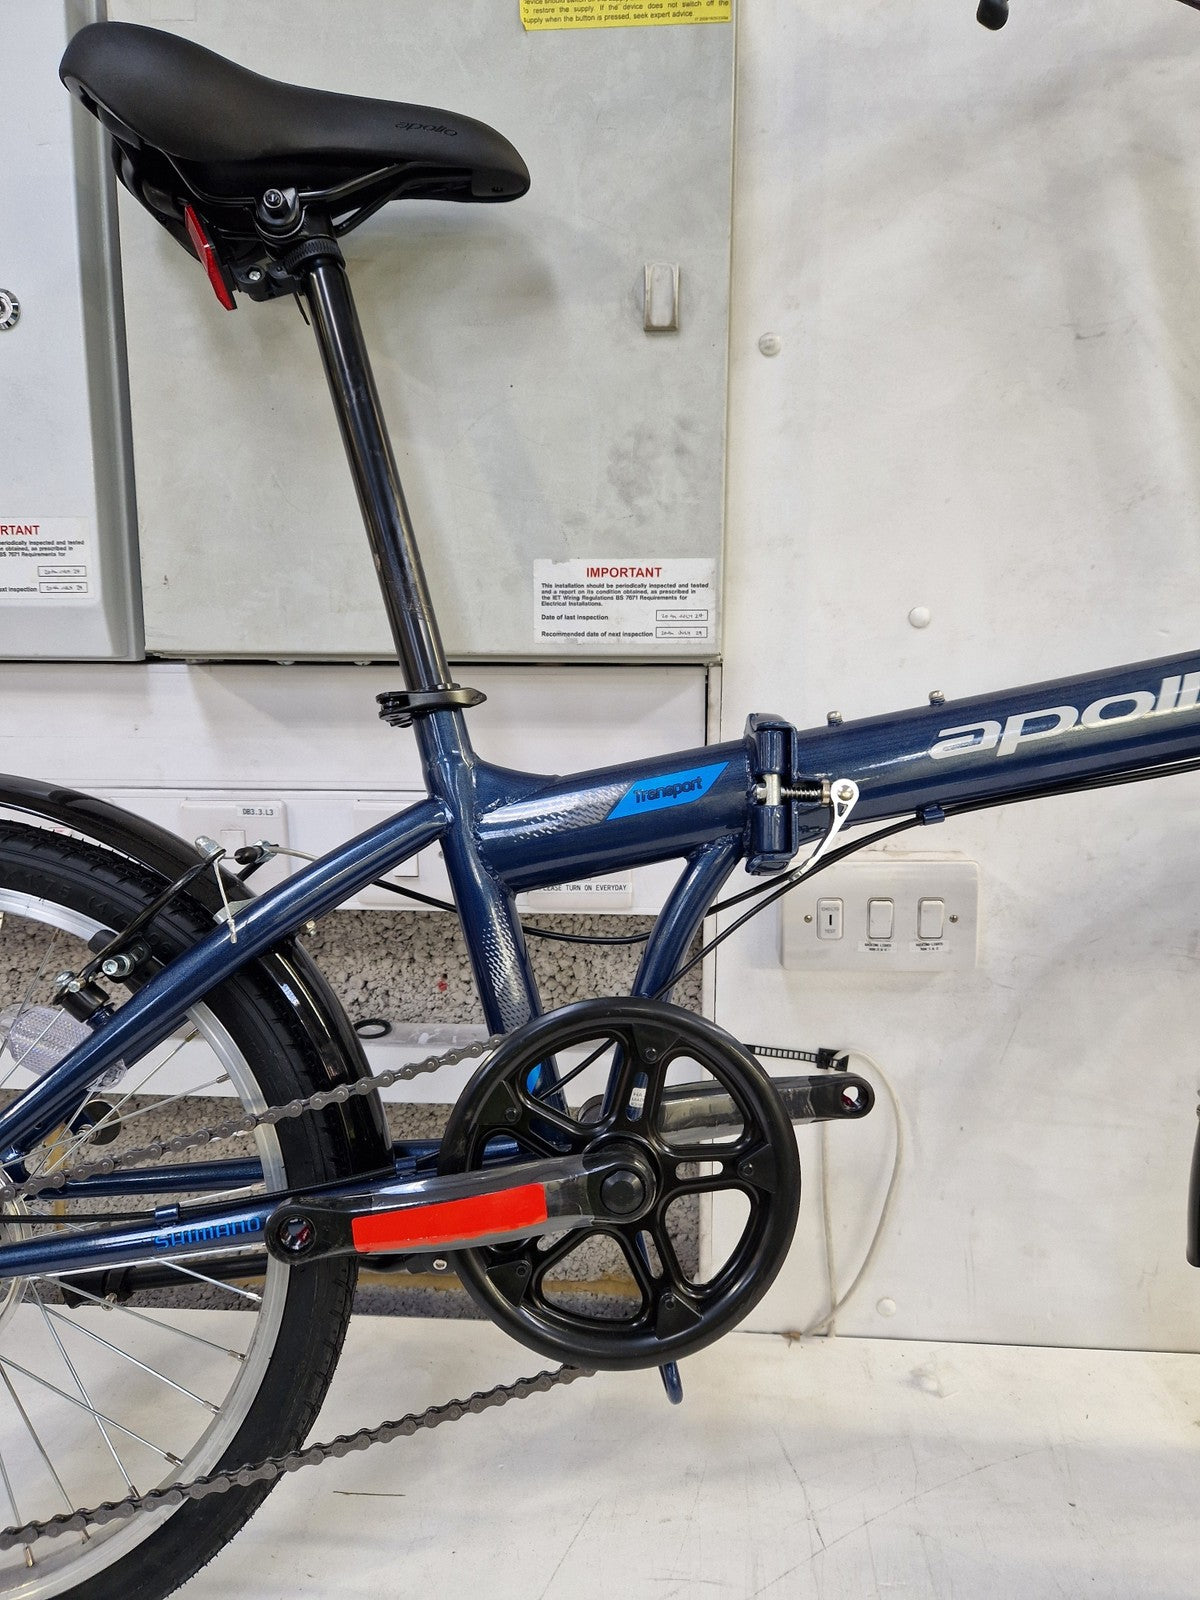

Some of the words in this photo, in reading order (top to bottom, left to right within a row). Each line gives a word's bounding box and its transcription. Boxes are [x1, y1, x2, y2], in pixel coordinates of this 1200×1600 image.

[574, 5, 594, 14] supply
[650, 11, 670, 19] expert
[0, 525, 40, 535] RTANT
[586, 567, 662, 578] IMPORTANT
[633, 776, 703, 804] Transport
[566, 884, 581, 892] TURN
[153, 1216, 261, 1249] SHIMANO
